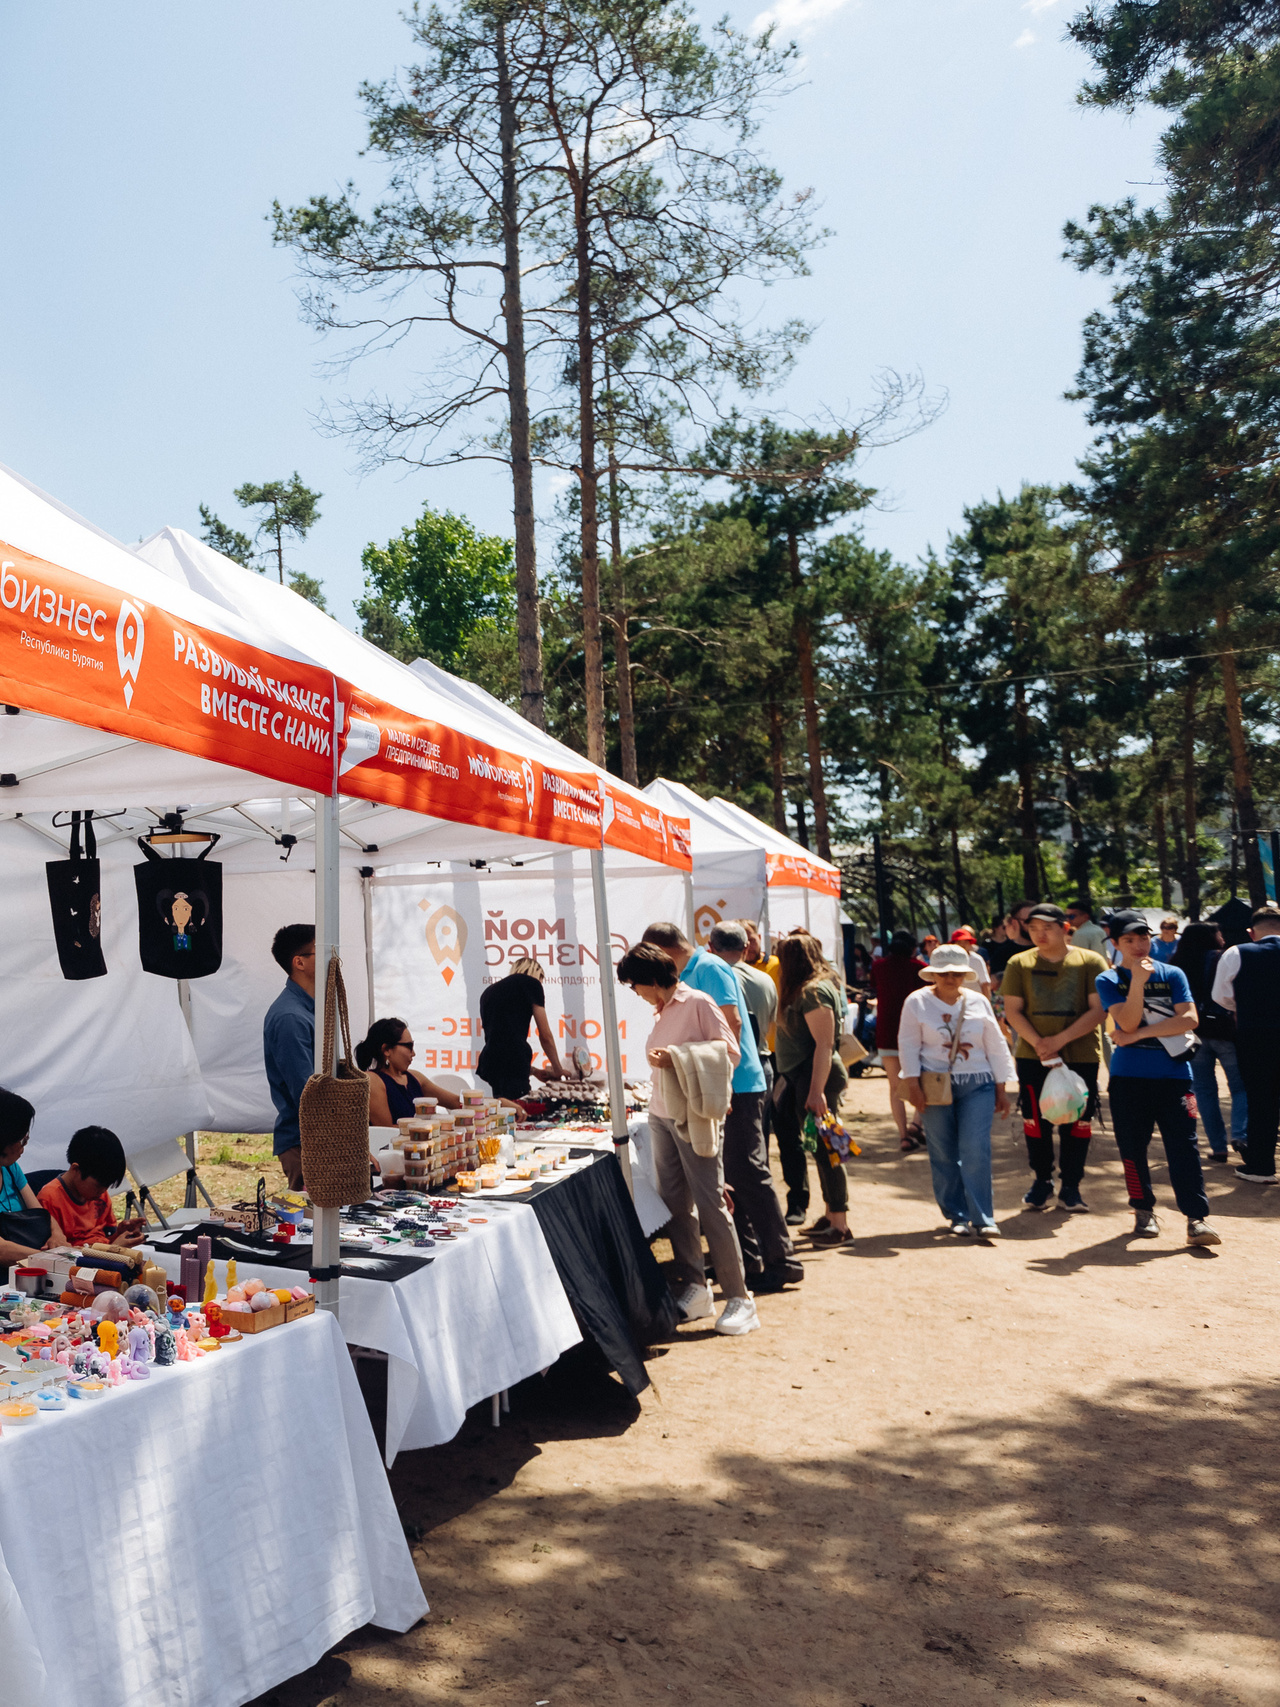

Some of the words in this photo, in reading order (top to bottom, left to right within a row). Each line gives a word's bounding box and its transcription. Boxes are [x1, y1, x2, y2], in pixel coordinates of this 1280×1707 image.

[20, 630, 70, 660] Республика
[72, 648, 104, 671] Бурятия
[173, 630, 272, 698] РАЗВИВАЙ
[266, 677, 331, 723] БИЗНЕС
[201, 683, 270, 736] ВМЕСТЕ
[270, 711, 284, 740] С
[284, 715, 331, 757] НАМИ
[385, 745, 459, 780] ПРЕДПРИНИМАТЕЛЬСТВО
[386, 728, 410, 748] МАЛОЕ
[417, 738, 441, 758] СРЕДНЕЕ
